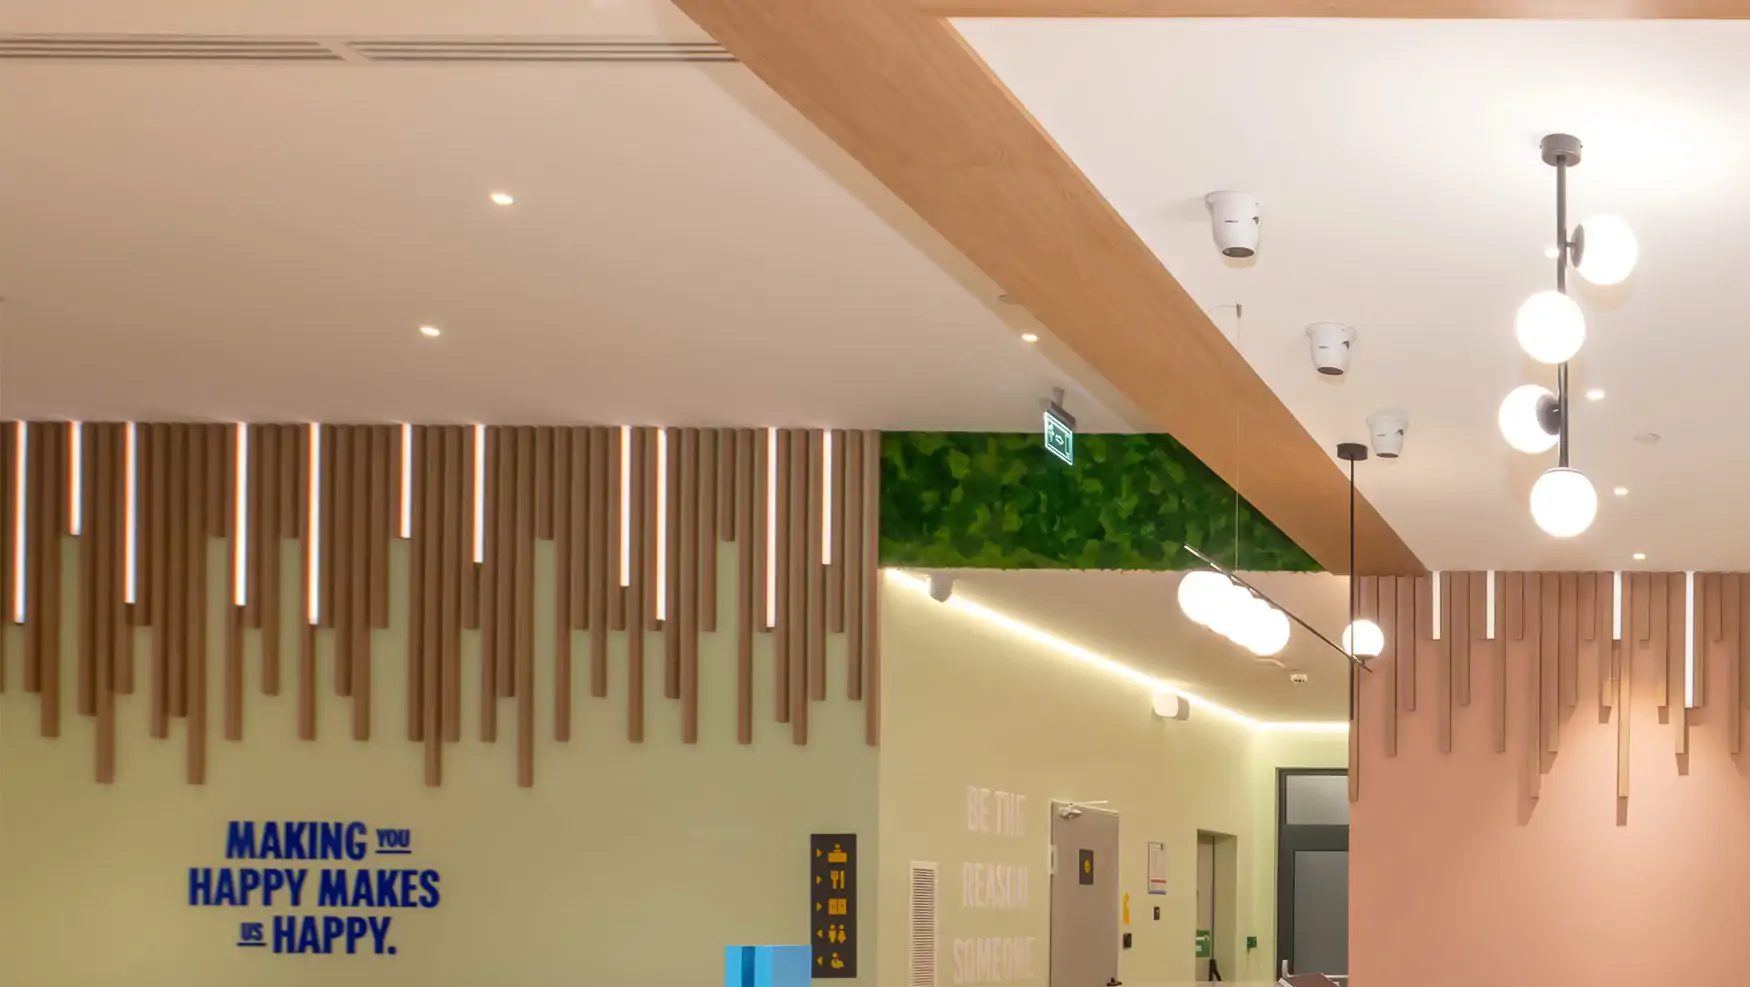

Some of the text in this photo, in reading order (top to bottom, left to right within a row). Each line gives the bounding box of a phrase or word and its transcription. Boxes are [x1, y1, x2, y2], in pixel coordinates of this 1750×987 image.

[967, 785, 1027, 837] BE THE
[225, 821, 411, 861] MAKING YOU
[188, 867, 441, 909] HAPPY MAKES
[962, 861, 1029, 909] REASON
[240, 915, 397, 955] US HAPPY.
[953, 936, 1037, 985] SOMEONE
